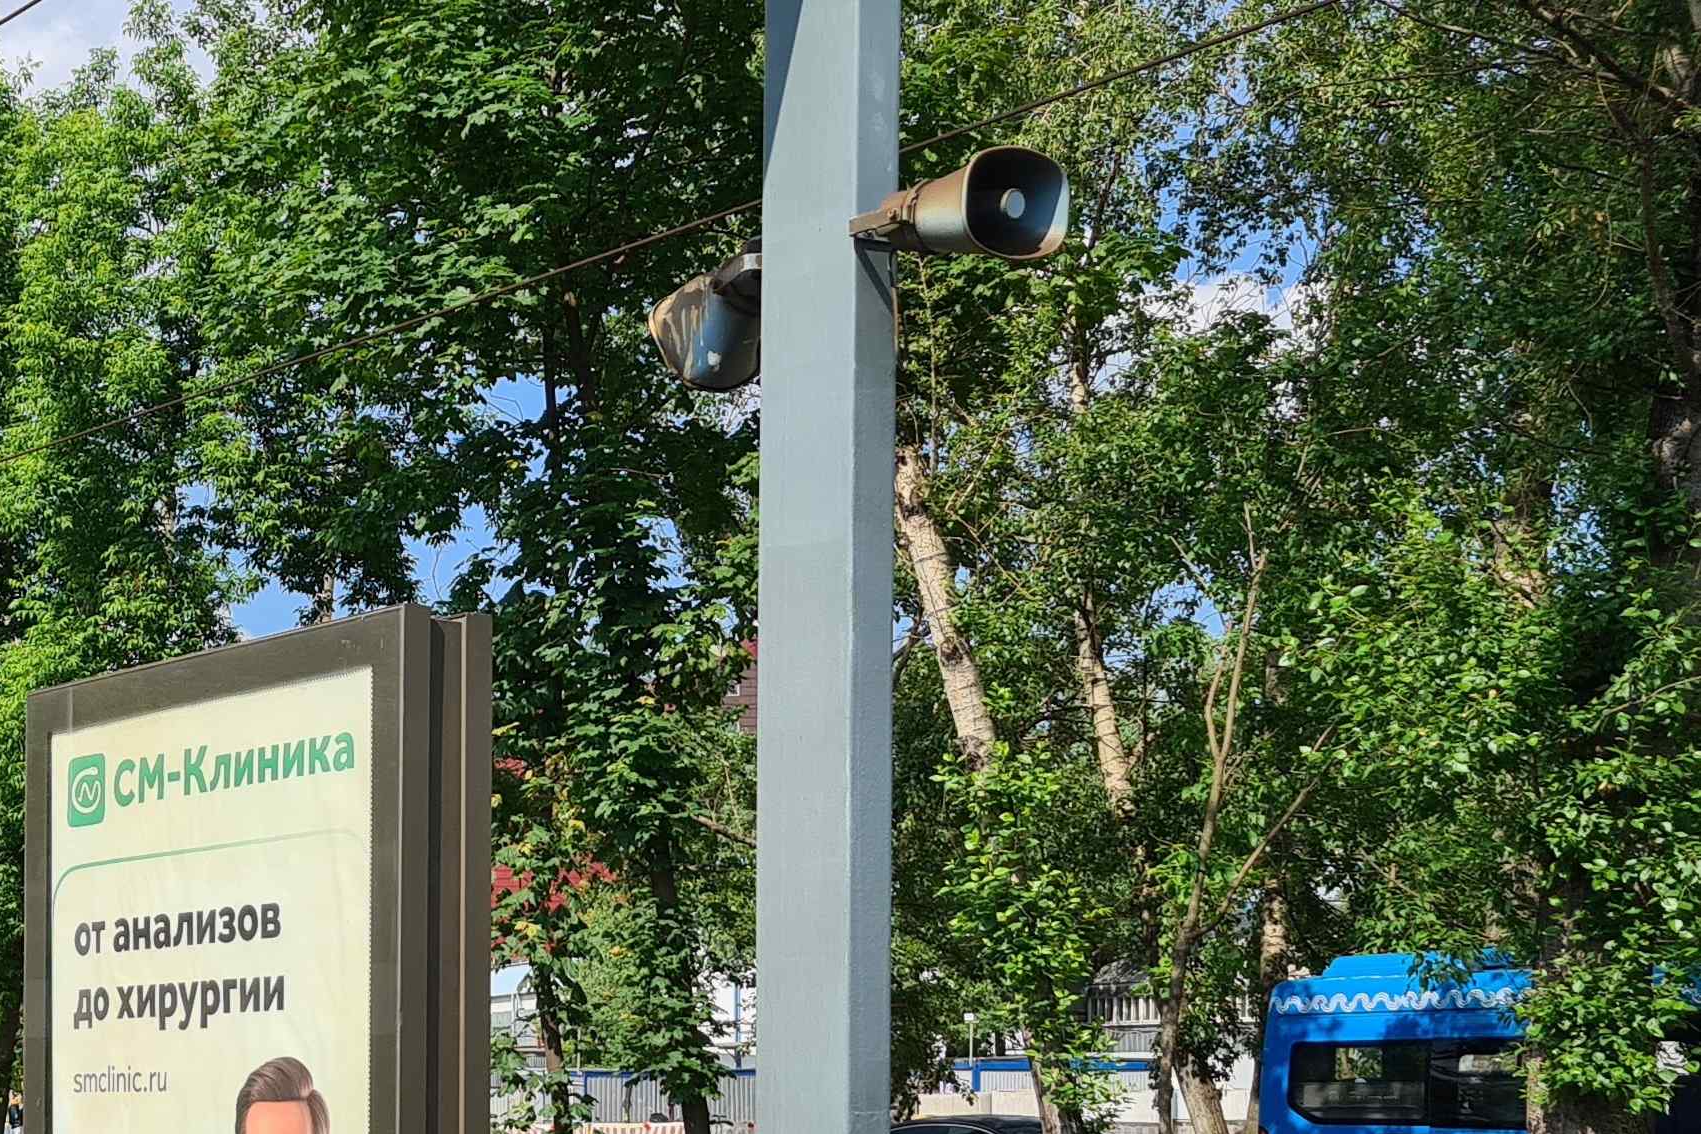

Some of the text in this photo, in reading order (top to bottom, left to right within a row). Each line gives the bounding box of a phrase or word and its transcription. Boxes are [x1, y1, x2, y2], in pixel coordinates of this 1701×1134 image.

[114, 731, 356, 807] СМ-Клиника
[74, 901, 282, 956] от анализов
[74, 974, 285, 1030] до хирургии
[73, 1065, 168, 1094] smclinic.ru
